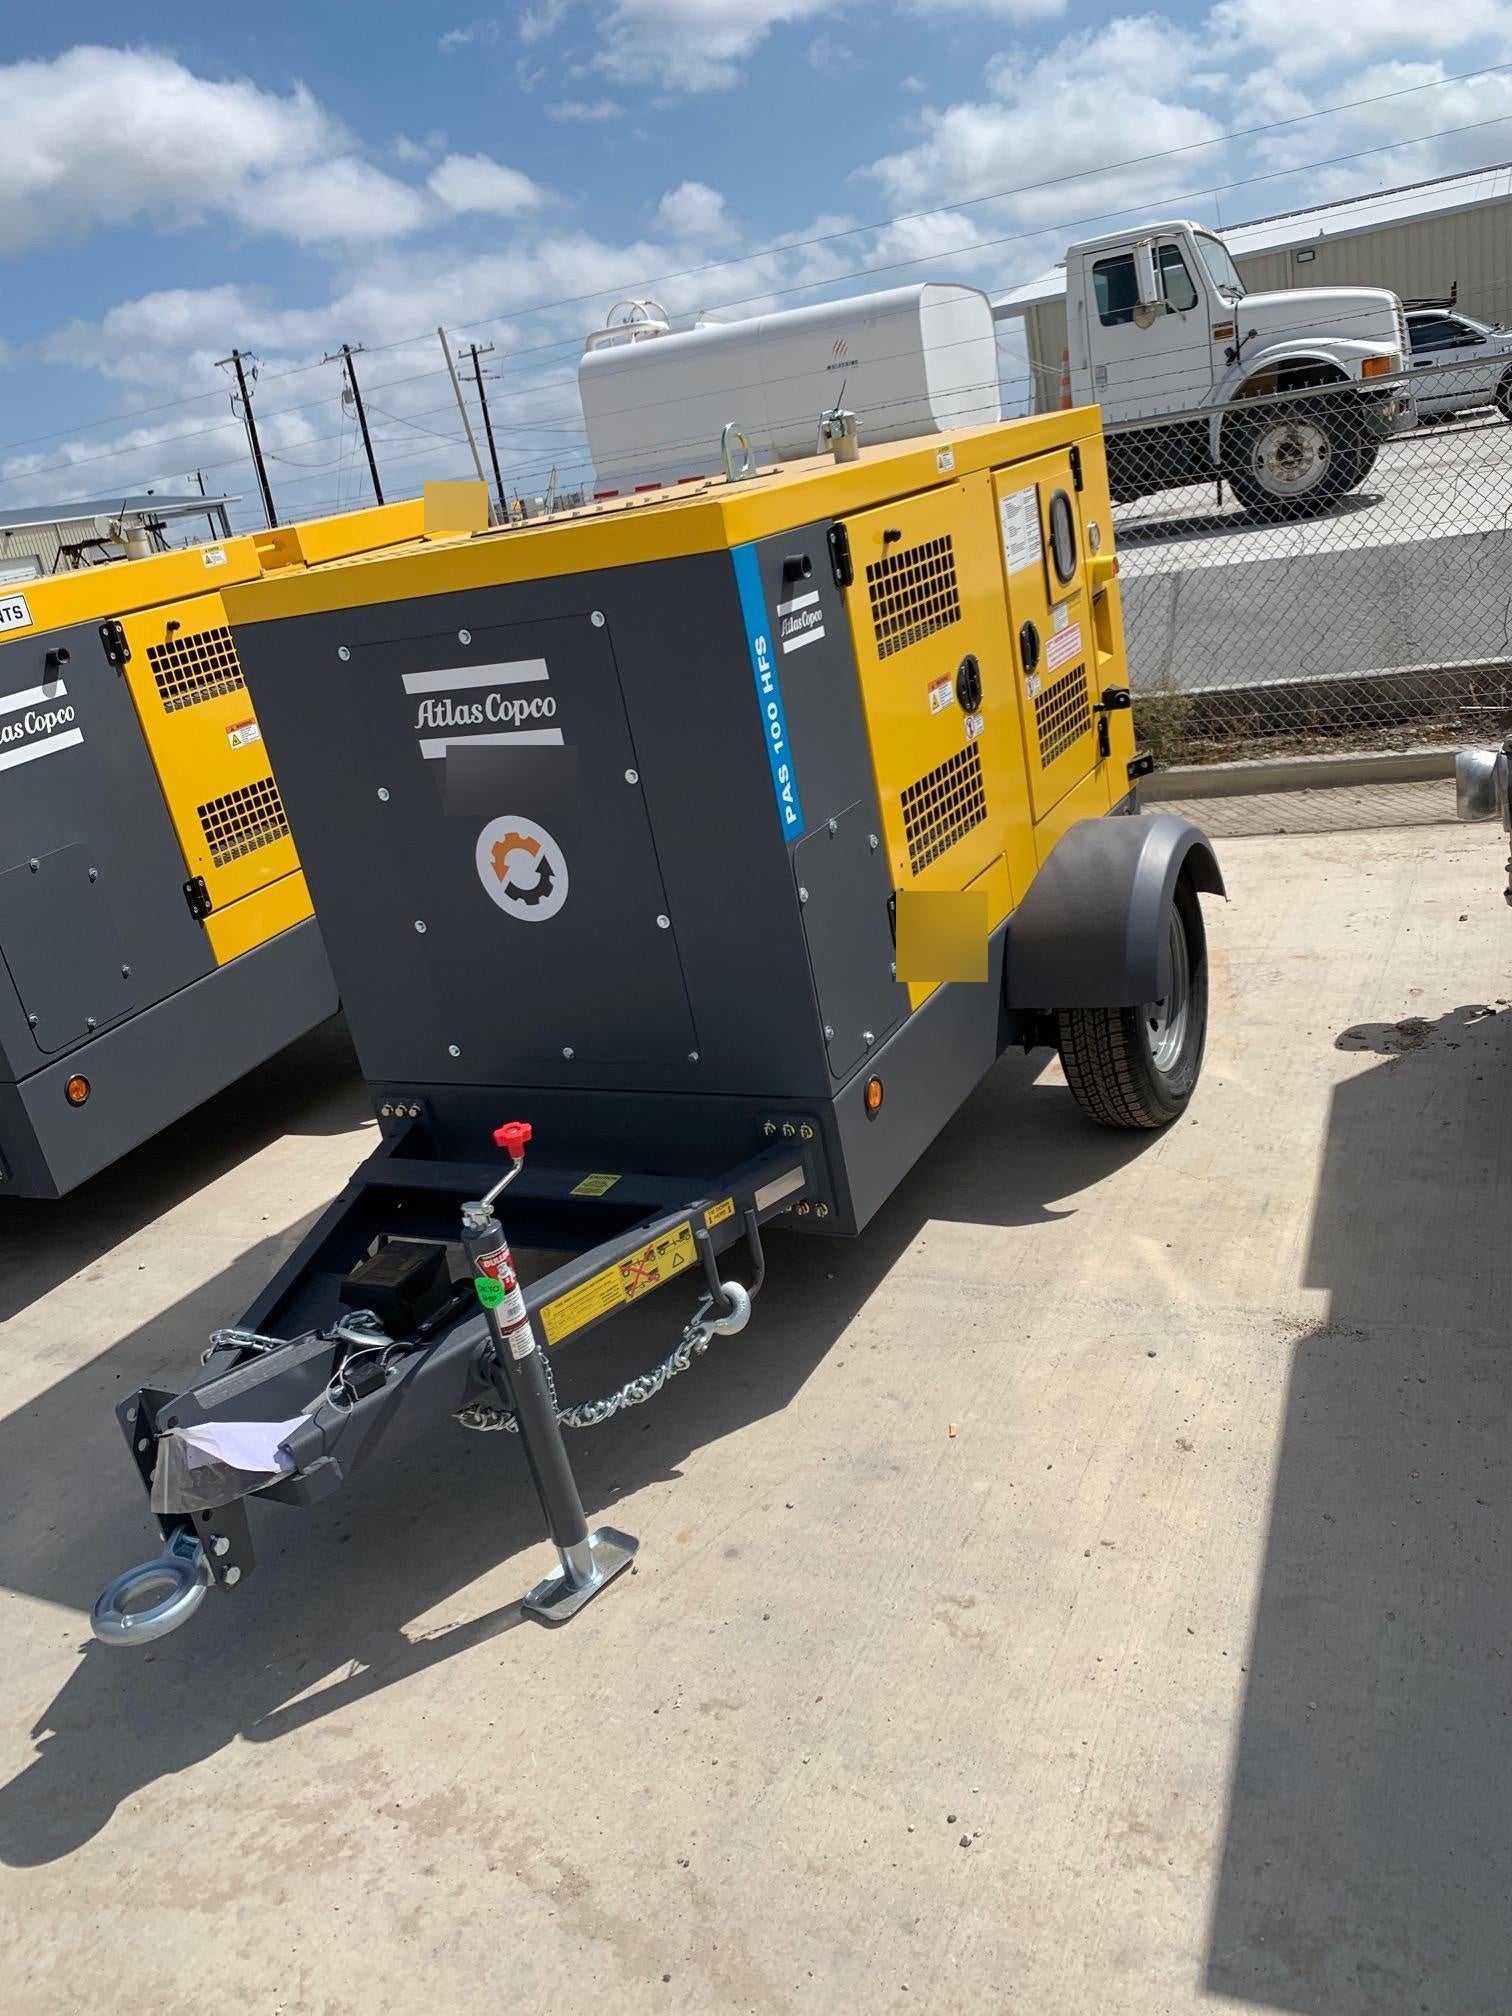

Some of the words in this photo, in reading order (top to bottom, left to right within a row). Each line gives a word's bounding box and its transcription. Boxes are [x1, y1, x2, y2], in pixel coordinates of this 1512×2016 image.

[781, 617, 803, 637] Atlas
[802, 609, 822, 628] Copco
[754, 635, 774, 694] HFS
[24, 706, 75, 734] Copco
[414, 699, 484, 729] Atlas
[485, 693, 557, 726] Copco
[767, 702, 784, 755] 100
[778, 763, 797, 825] PAS
